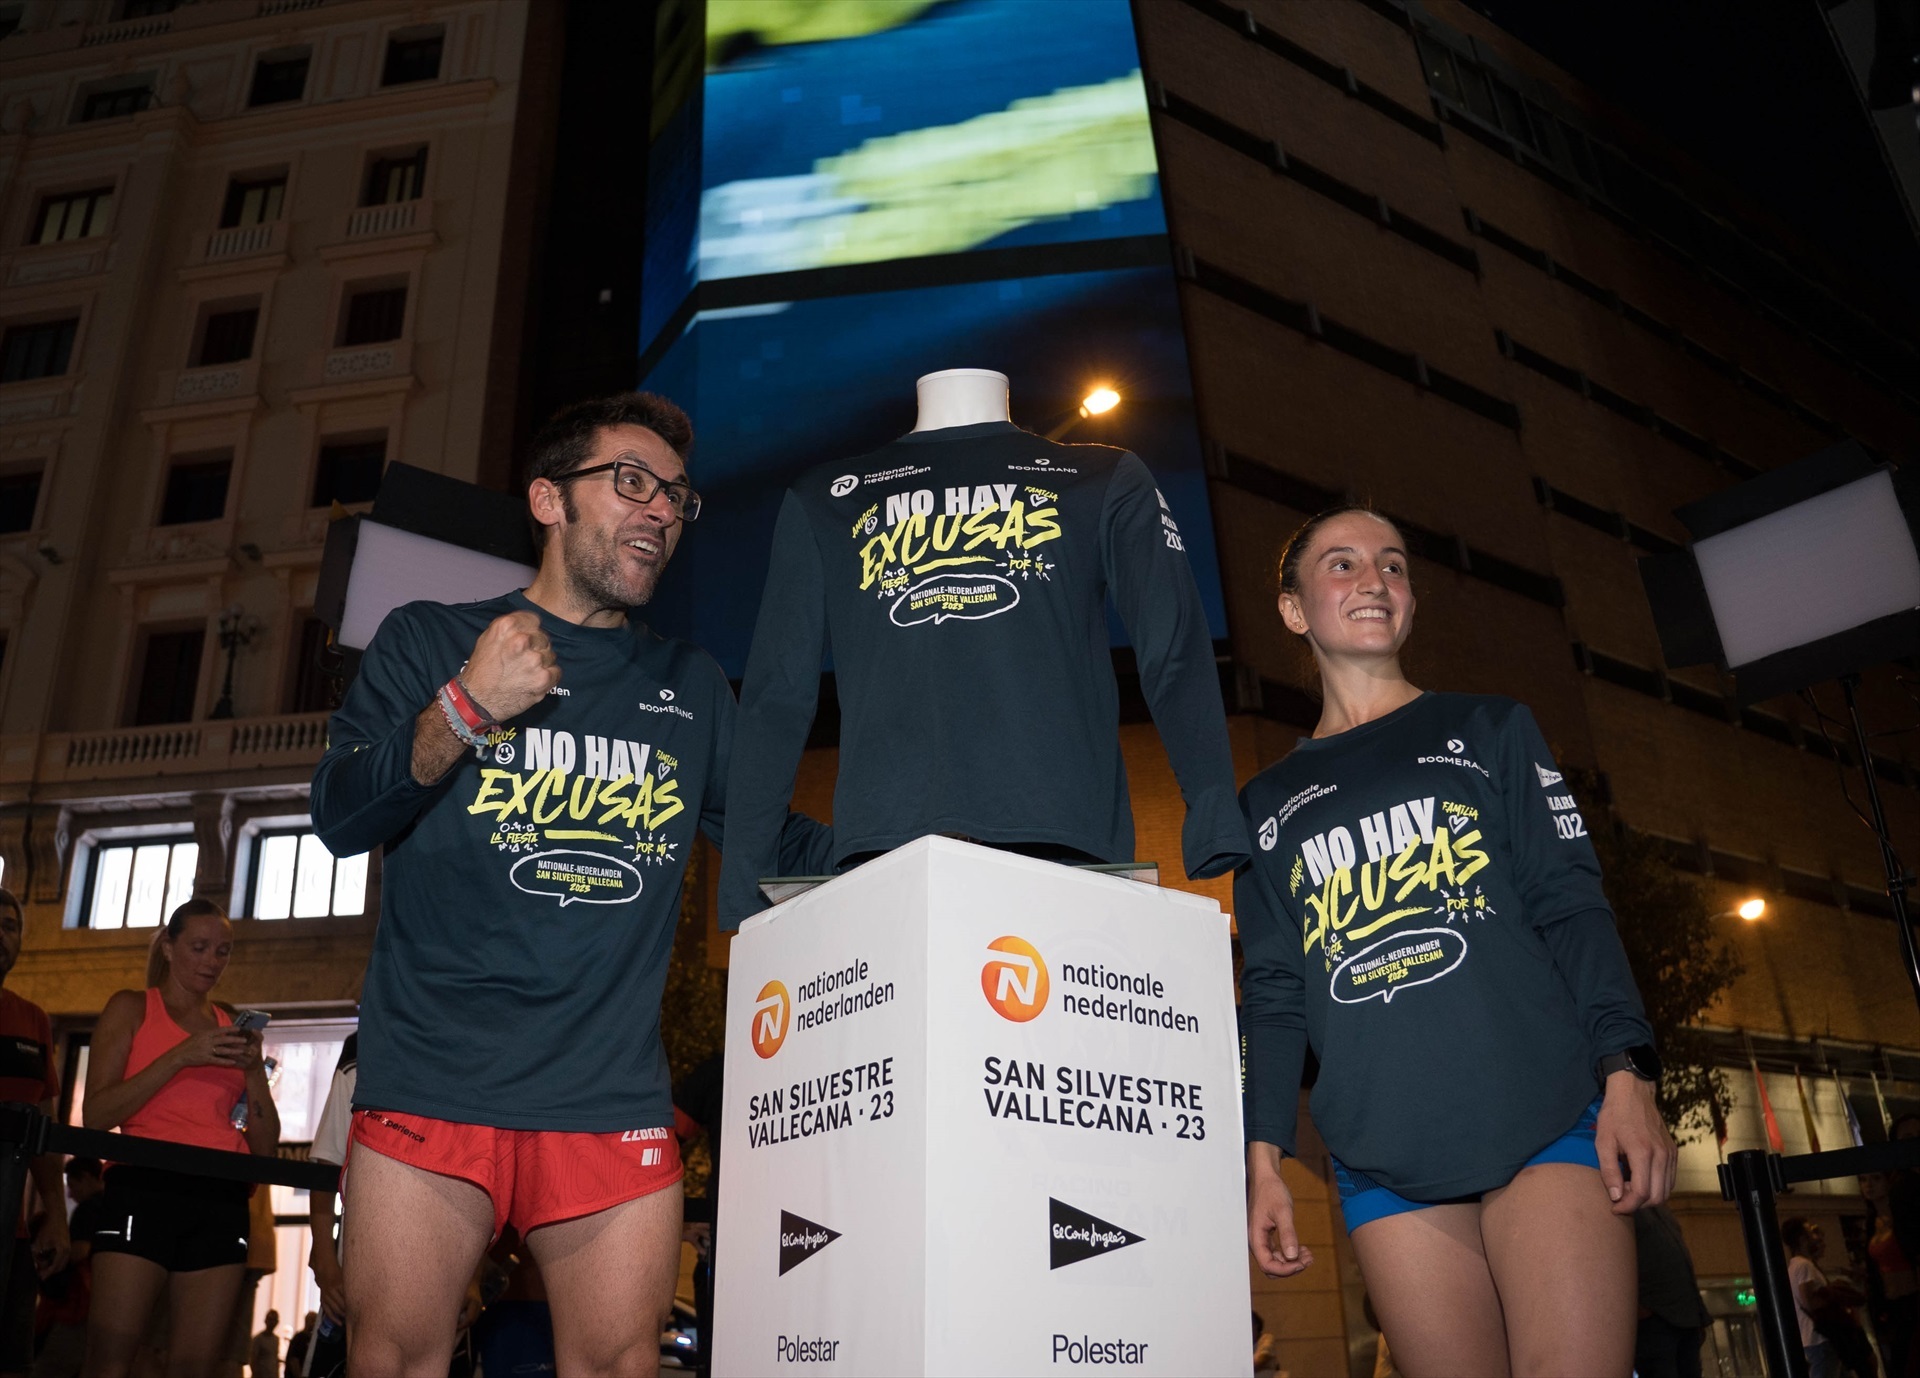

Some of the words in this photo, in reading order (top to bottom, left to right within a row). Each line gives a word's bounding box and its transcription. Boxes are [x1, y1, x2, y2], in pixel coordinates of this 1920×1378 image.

[864, 465, 914, 479] nationale
[864, 466, 931, 485] nederlanden
[1007, 464, 1078, 474] BOOMERANG
[852, 503, 879, 539] AMIGOS
[886, 490, 934, 526] NO
[945, 484, 1018, 516] HAY
[859, 501, 1062, 591] EXCUSAS
[1009, 559, 1032, 571] POR
[910, 584, 996, 602] NATIONALE-NEDERLANDEN
[910, 600, 923, 611] SAN
[925, 595, 959, 608] SILVESTRE
[960, 591, 998, 604] VALLECANA
[545, 685, 570, 697] den
[639, 702, 694, 720] BOOMERANG
[525, 727, 576, 776] NO
[584, 735, 650, 786] HAY
[1417, 756, 1490, 778] BOOMERANG
[467, 768, 685, 831] EXCUSAS
[1278, 784, 1320, 816] nationale
[1280, 784, 1337, 826] nederlanden
[1442, 801, 1478, 820] FAMILIA
[490, 833, 504, 844] LA
[506, 832, 539, 844] FIESTA
[636, 842, 654, 854] POR
[1301, 826, 1356, 886] NO
[1360, 797, 1435, 863] HAY
[536, 870, 550, 880] SAN
[552, 871, 586, 884] SILVESTRE
[587, 877, 623, 888] VALLECANA
[537, 860, 622, 879] NATIONALE-NEDERLANDEN
[1304, 827, 1490, 956] EXCUSAS
[1447, 897, 1470, 912] POR
[1350, 938, 1441, 975] NATIONALE-NEDERLANDEN
[1352, 972, 1367, 985] SAN
[1367, 963, 1402, 983] SILVESTRE
[1402, 949, 1444, 970] VALLECANA
[798, 957, 869, 1004] nationale
[1063, 962, 1164, 998] nationale
[796, 981, 894, 1032] nederlanden
[1064, 993, 1200, 1034] nederlanden
[748, 1088, 783, 1121] SAN
[789, 1057, 894, 1109] SILVESTRE
[983, 1056, 1046, 1091] SAN
[1056, 1066, 1203, 1112] SILVESTRE
[748, 1106, 852, 1150] VALLECANA
[869, 1091, 894, 1122] 23
[983, 1088, 1154, 1136] VALLECANA
[1174, 1115, 1206, 1142] 23
[1053, 1223, 1064, 1239] El
[1065, 1224, 1090, 1242] Corte
[776, 1334, 840, 1363] Polestar
[1052, 1334, 1148, 1365] Polestar
